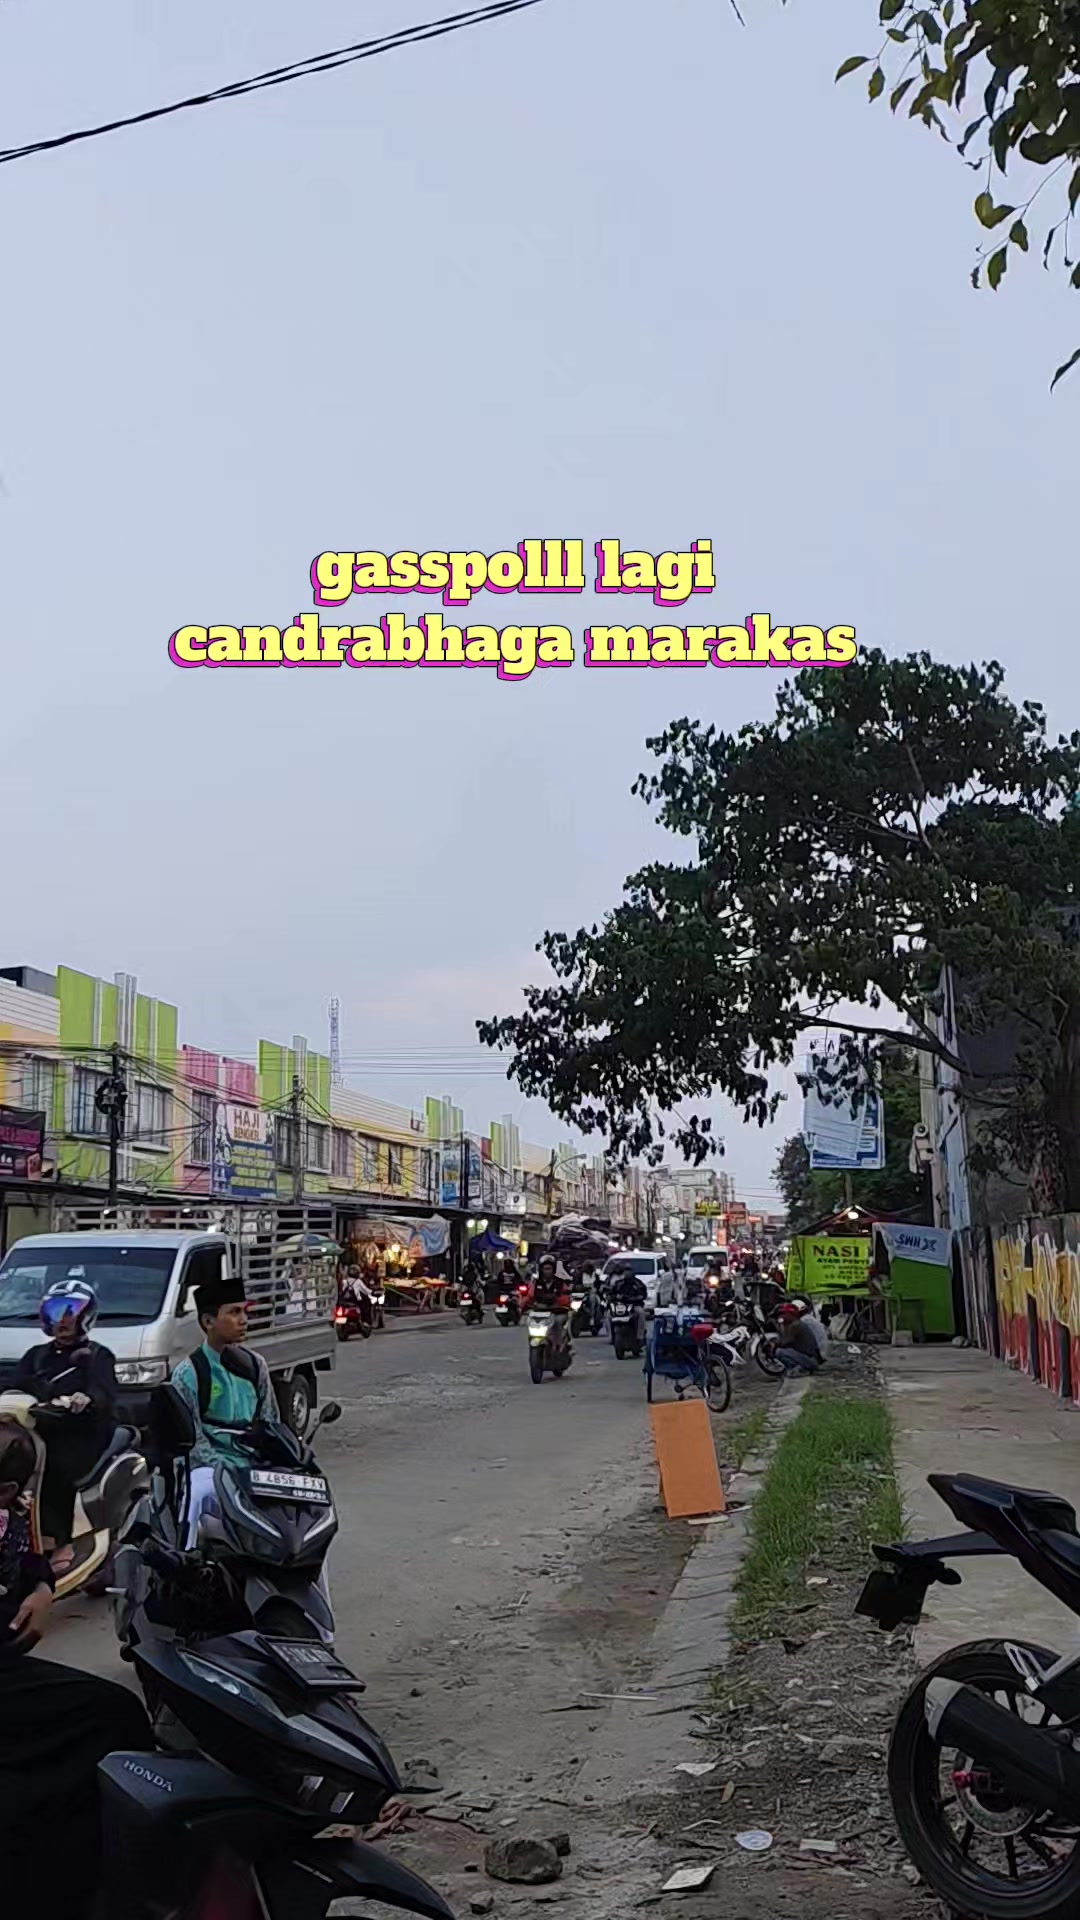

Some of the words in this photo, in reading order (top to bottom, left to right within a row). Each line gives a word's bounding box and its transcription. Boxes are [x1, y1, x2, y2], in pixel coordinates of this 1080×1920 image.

[233, 1109, 260, 1129] HAJI
[812, 1244, 860, 1257] NASI
[123, 1760, 173, 1793] HONDA
